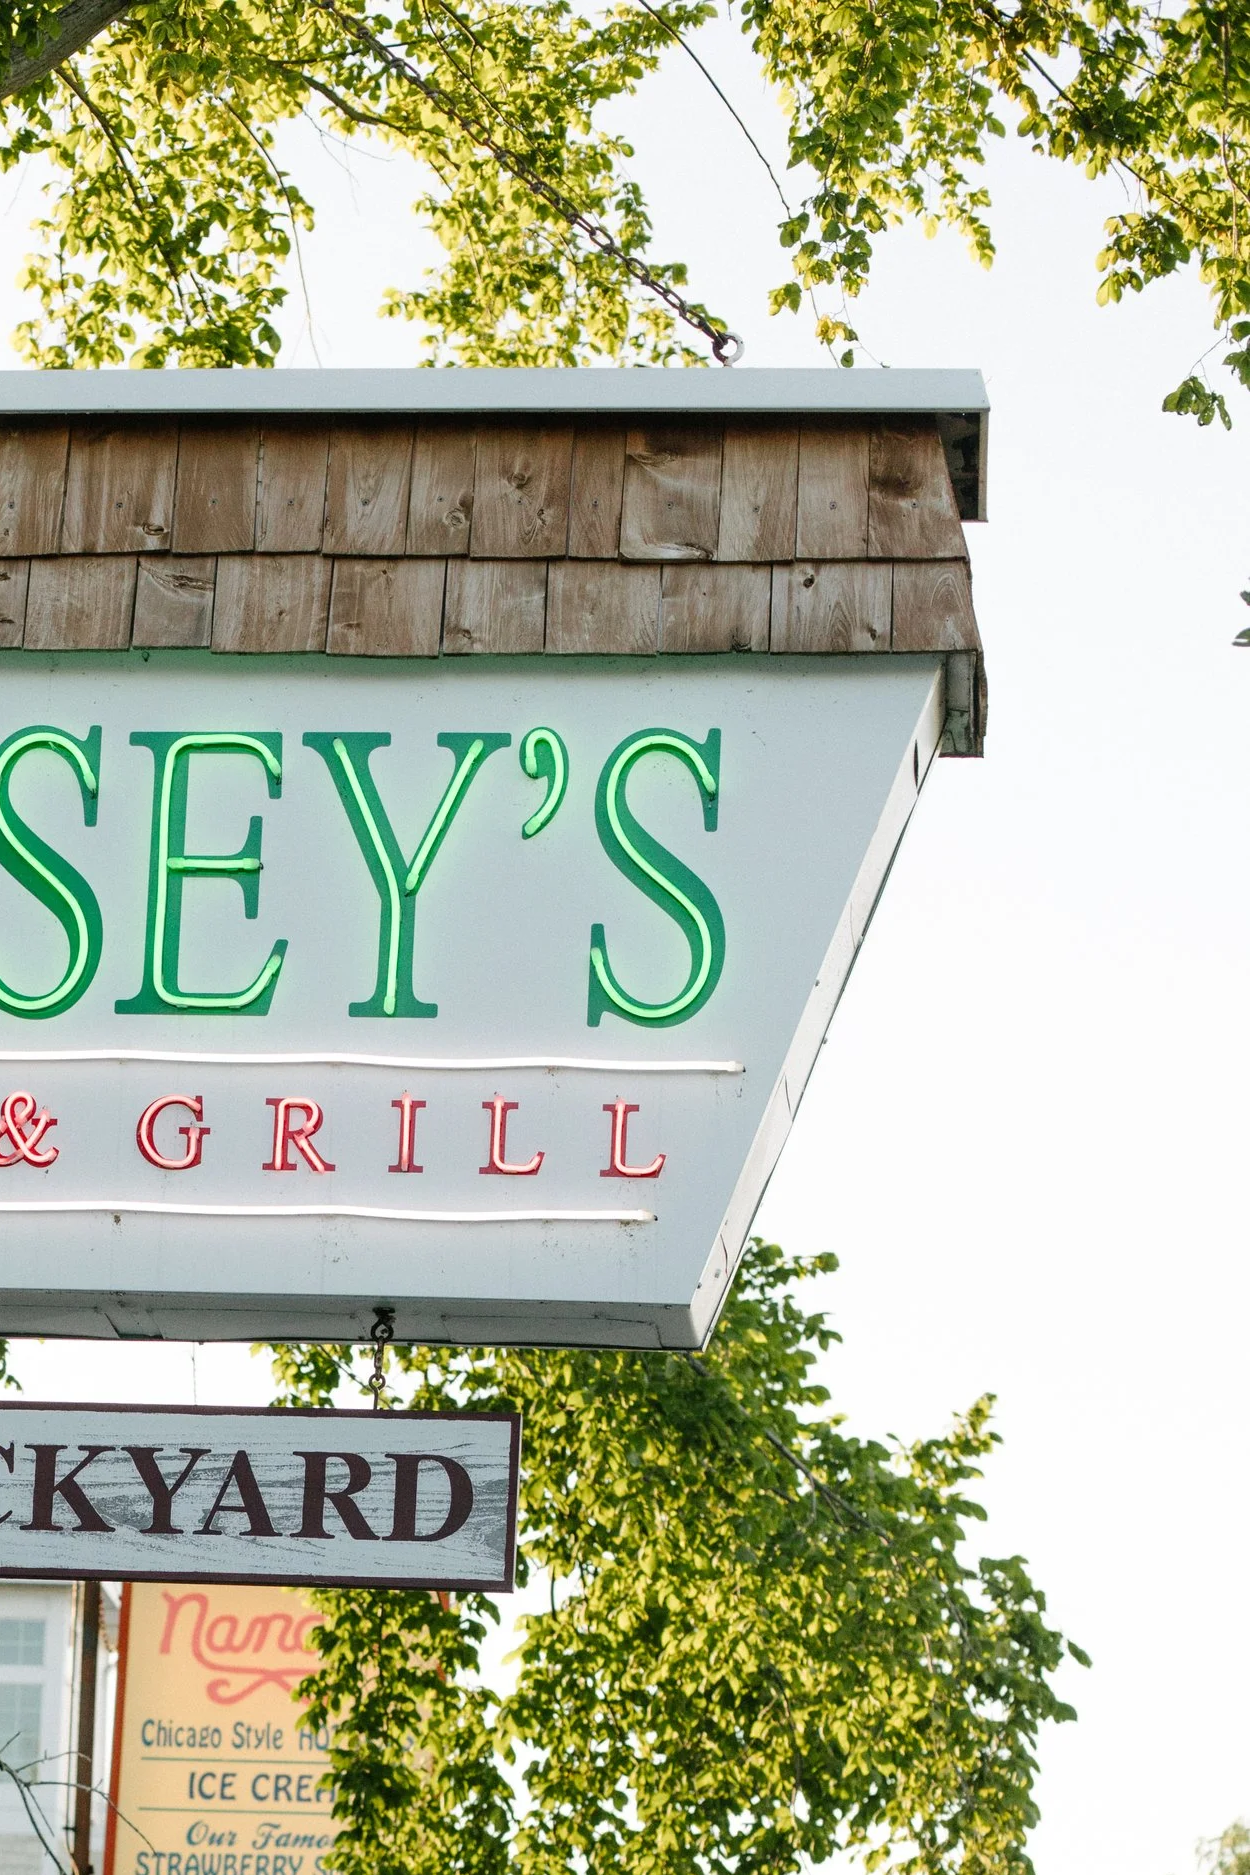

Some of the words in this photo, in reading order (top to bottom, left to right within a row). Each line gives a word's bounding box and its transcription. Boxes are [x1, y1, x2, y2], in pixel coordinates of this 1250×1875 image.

[135, 1094, 668, 1179] GRILL
[141, 1718, 223, 1750] Chicago
[231, 1721, 284, 1751] Style
[299, 1720, 340, 1751] HO
[188, 1771, 237, 1801] ICE
[186, 1820, 238, 1848] Our
[251, 1822, 334, 1850] Famo
